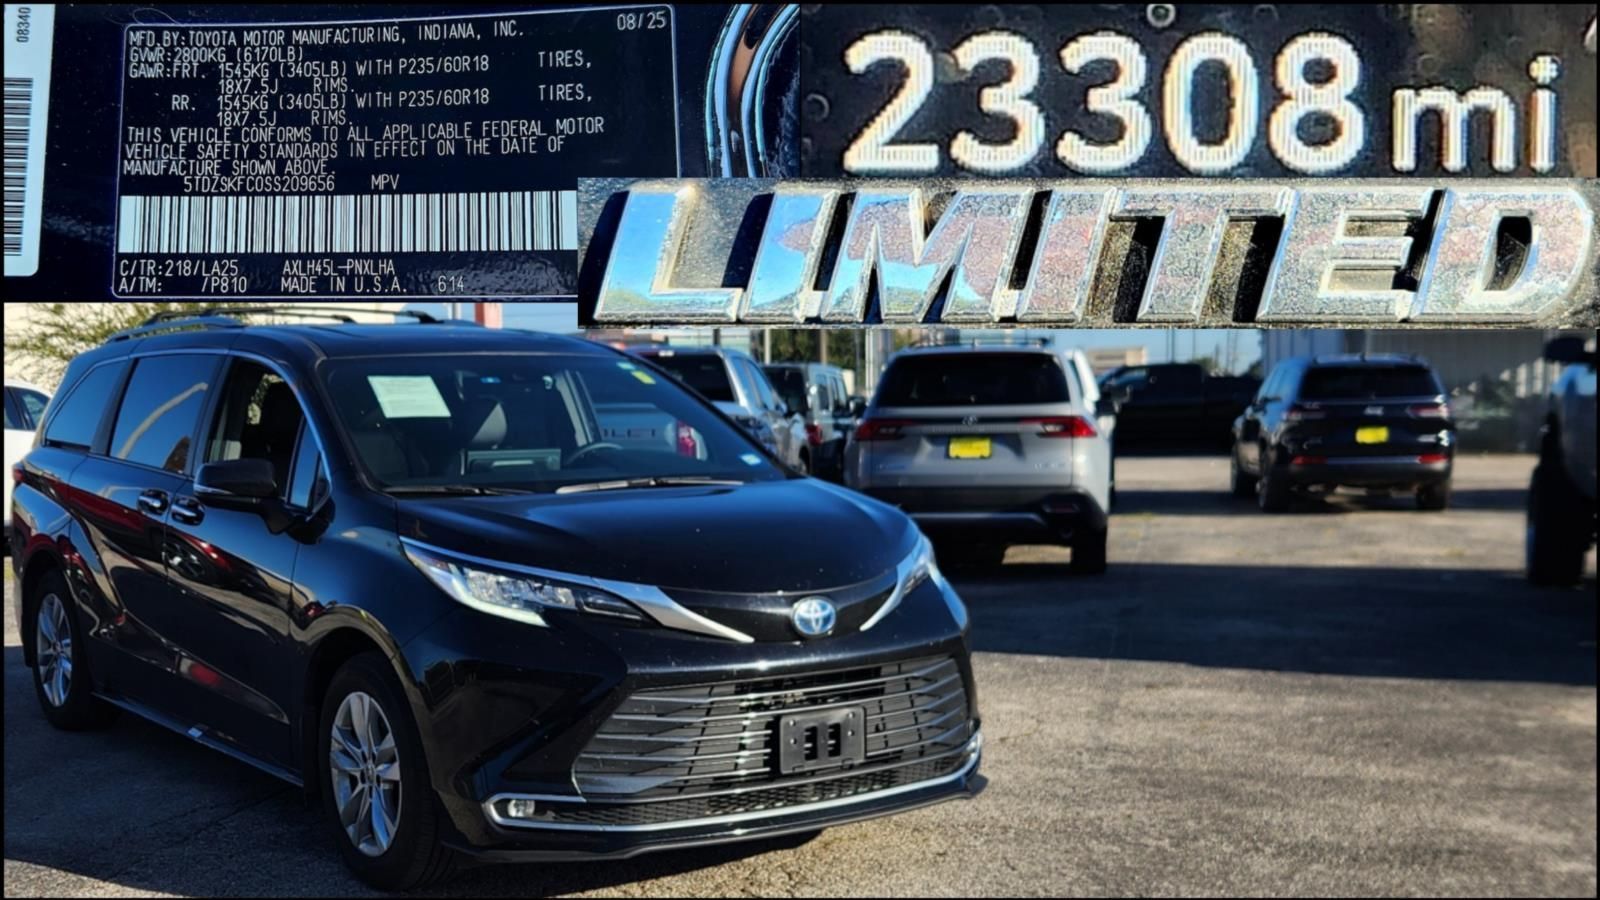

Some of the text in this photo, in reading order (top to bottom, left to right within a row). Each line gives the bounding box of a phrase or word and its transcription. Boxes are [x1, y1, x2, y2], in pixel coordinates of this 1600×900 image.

[16, 7, 31, 43] 08340
[616, 11, 668, 30] 08/25
[243, 30, 285, 47] MOTOR
[292, 26, 406, 45] MANUFACTURING,
[418, 23, 481, 41] INDIANA,
[494, 19, 524, 37] INC.
[218, 62, 269, 78] 1545KG
[280, 60, 346, 78] (3405LB)
[355, 59, 392, 76] WITH
[399, 55, 490, 74] P235/60R18
[538, 50, 592, 69] TIRES,
[236, 46, 303, 62] (6170LB)
[172, 83, 592, 111] RR. 1545KG (3405LB) WITH P235/60R18 TIRES,
[218, 77, 355, 94] 18X7.5J RIMS.
[844, 31, 1559, 174] 23308 mi
[128, 116, 605, 144] THIS VEHICLE CONFORMS TO ALL APPLICABLE FEDERAL MOTOR
[217, 110, 353, 127] 18X7.5J RIMS.
[126, 134, 567, 160] VEHICLE SAFETY STANDARDS IN EFFECT ON THE DATE OF
[123, 158, 336, 176] MANUFACTURE SHOWN ABOVE.
[370, 173, 400, 191] MPV
[592, 187, 1590, 323] LIMITED
[282, 258, 396, 276] AXLH45L-PNXLHA
[280, 275, 318, 294] MADE
[330, 275, 346, 293] IN
[354, 275, 408, 294] U.S.A.
[437, 274, 465, 293] 614
